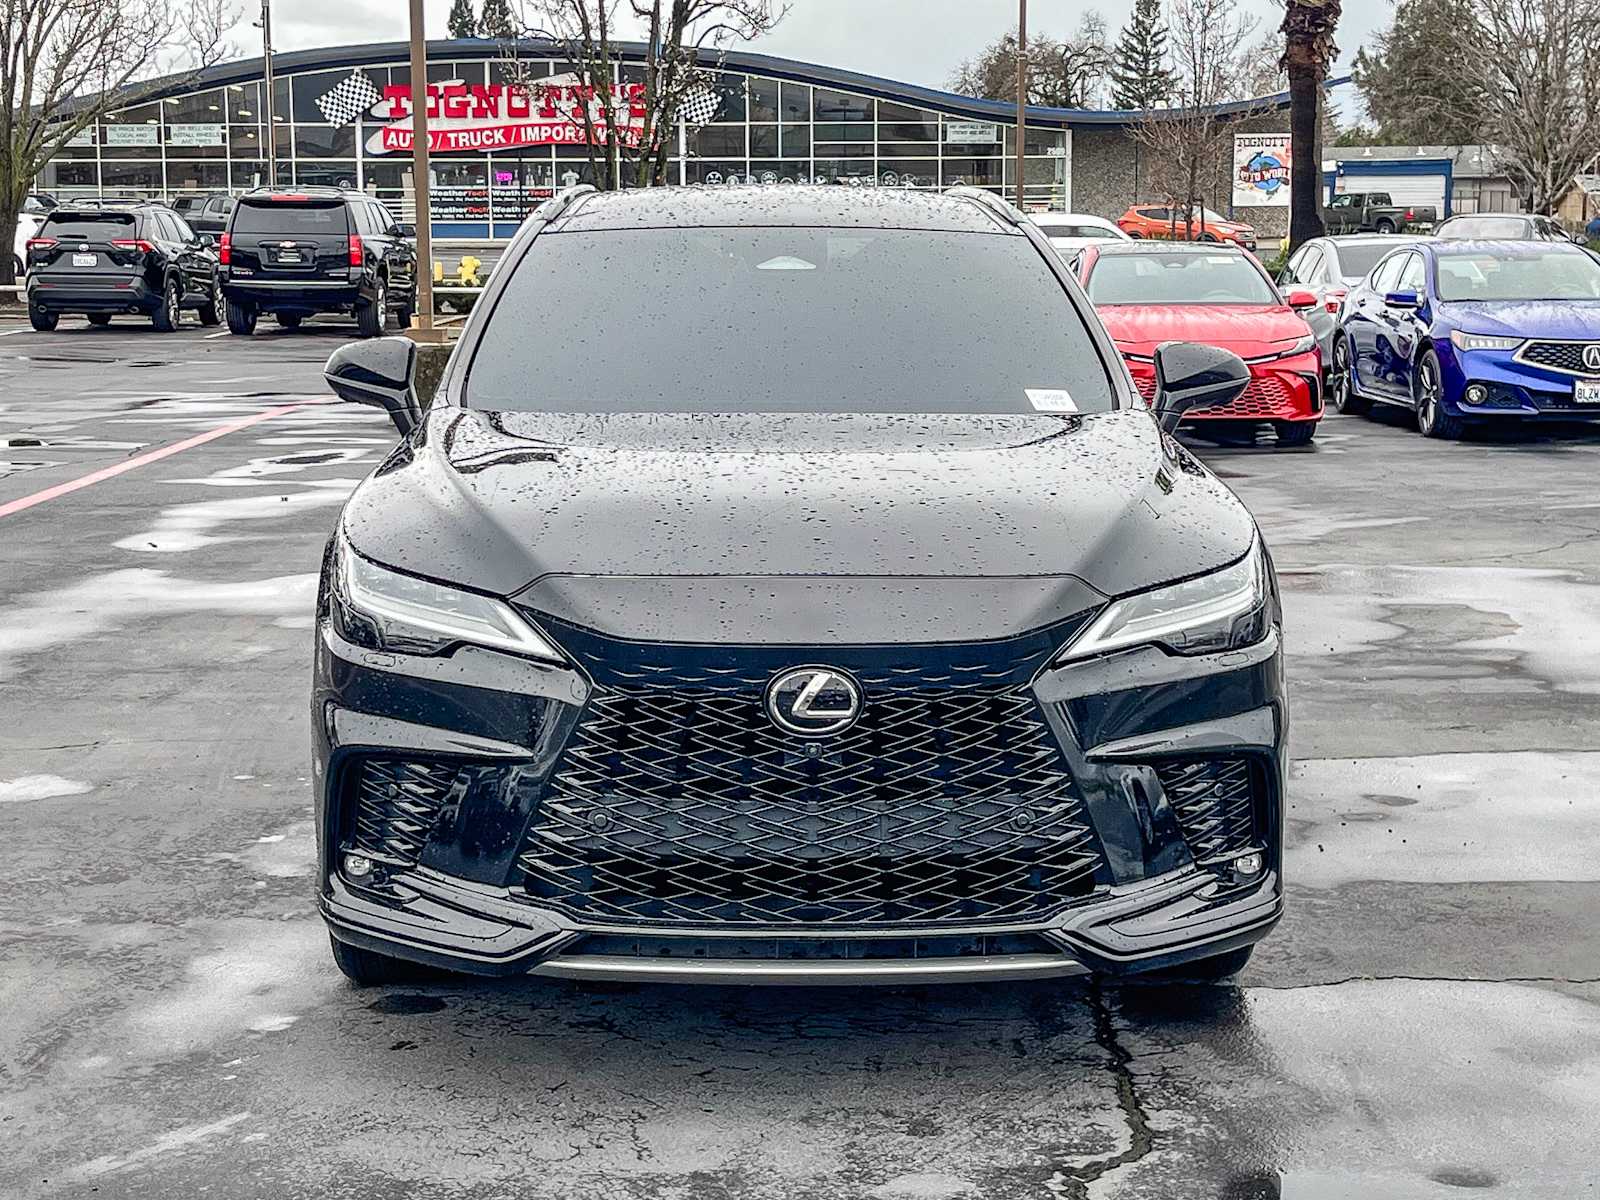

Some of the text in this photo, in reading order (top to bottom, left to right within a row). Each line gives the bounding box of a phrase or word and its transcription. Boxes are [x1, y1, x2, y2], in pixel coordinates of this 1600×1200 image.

[383, 84, 649, 118] TOGNOTT'S
[386, 131, 434, 148] AUO
[447, 129, 506, 148] TRUCK
